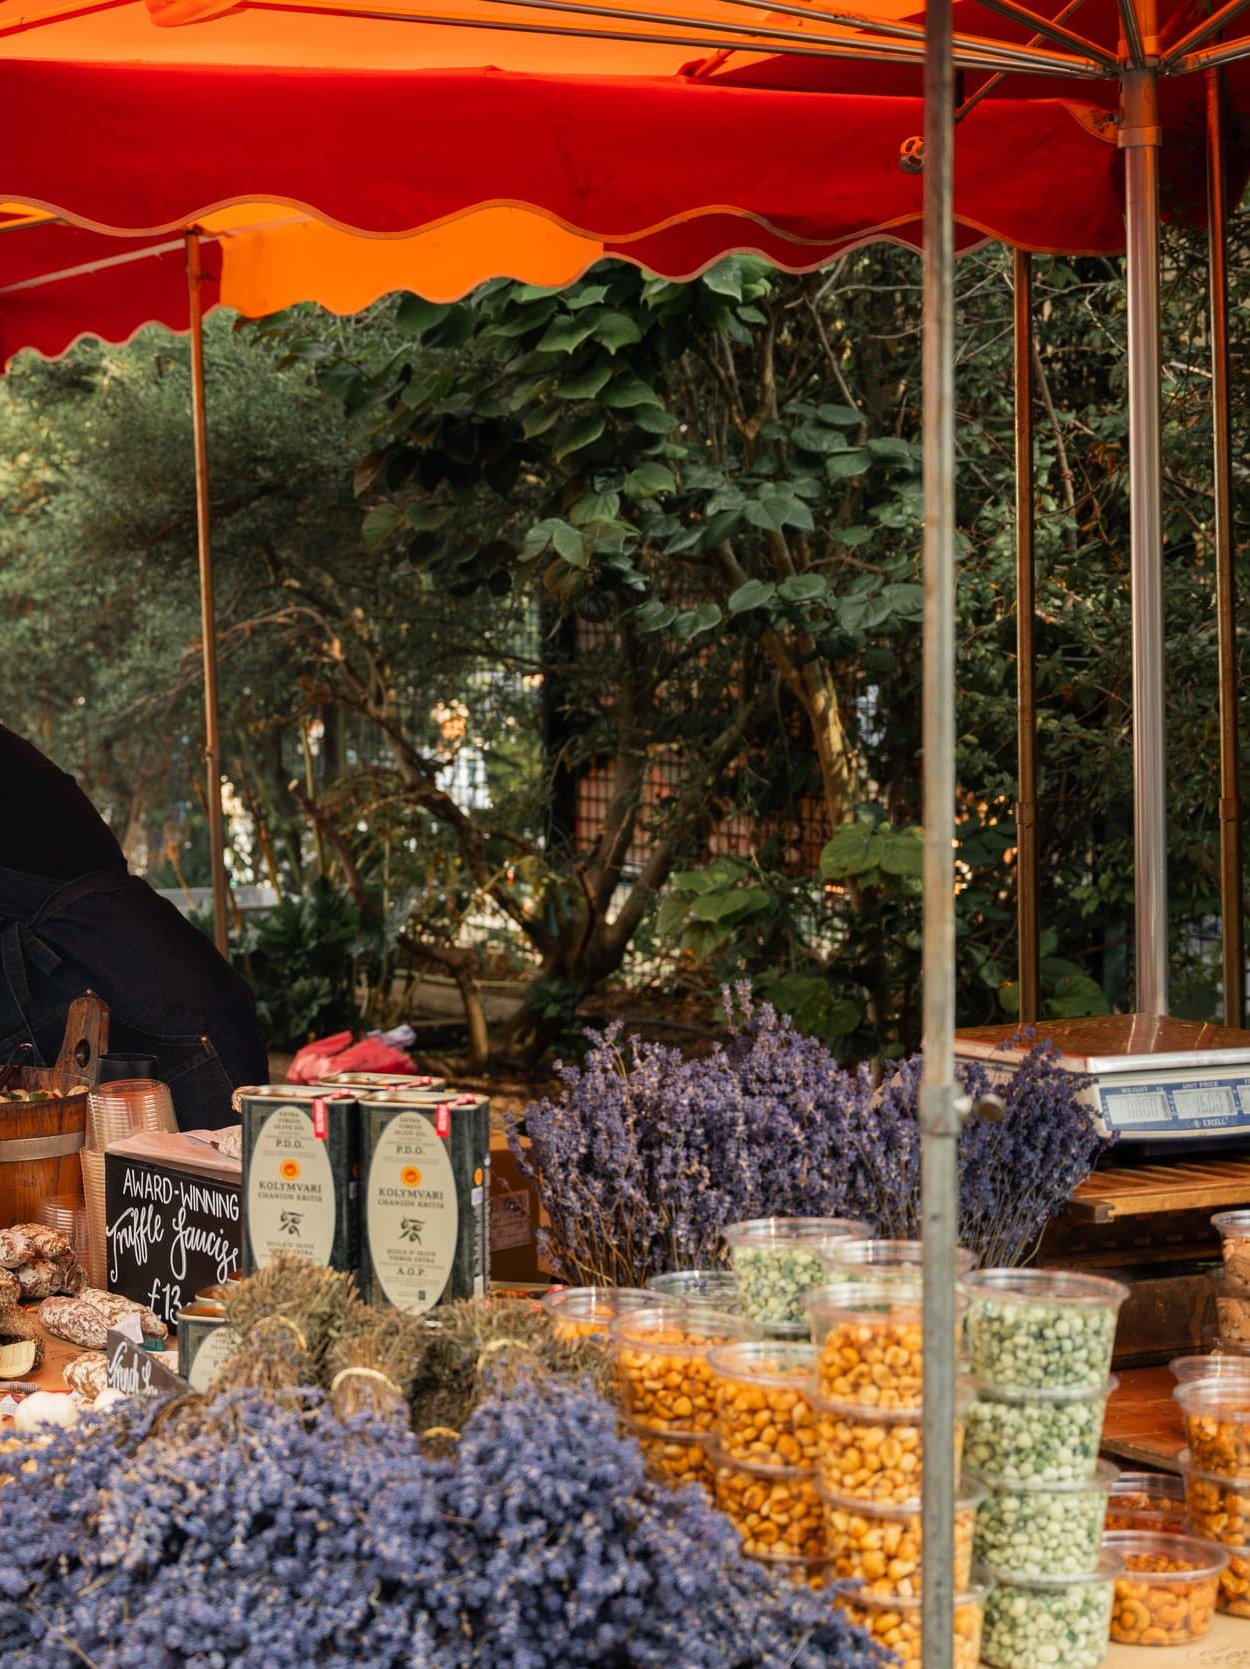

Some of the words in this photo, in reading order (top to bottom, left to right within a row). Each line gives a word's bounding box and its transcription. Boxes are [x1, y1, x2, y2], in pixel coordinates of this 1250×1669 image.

[1120, 1086, 1148, 1094] WEIGHT
[1199, 1080, 1219, 1088] PRICE
[258, 1180, 323, 1194] KOLYMVARI
[378, 1187, 444, 1200] KOLYMVARI
[122, 1167, 239, 1222] AWARD-WINNING
[105, 1203, 165, 1284] Truffle
